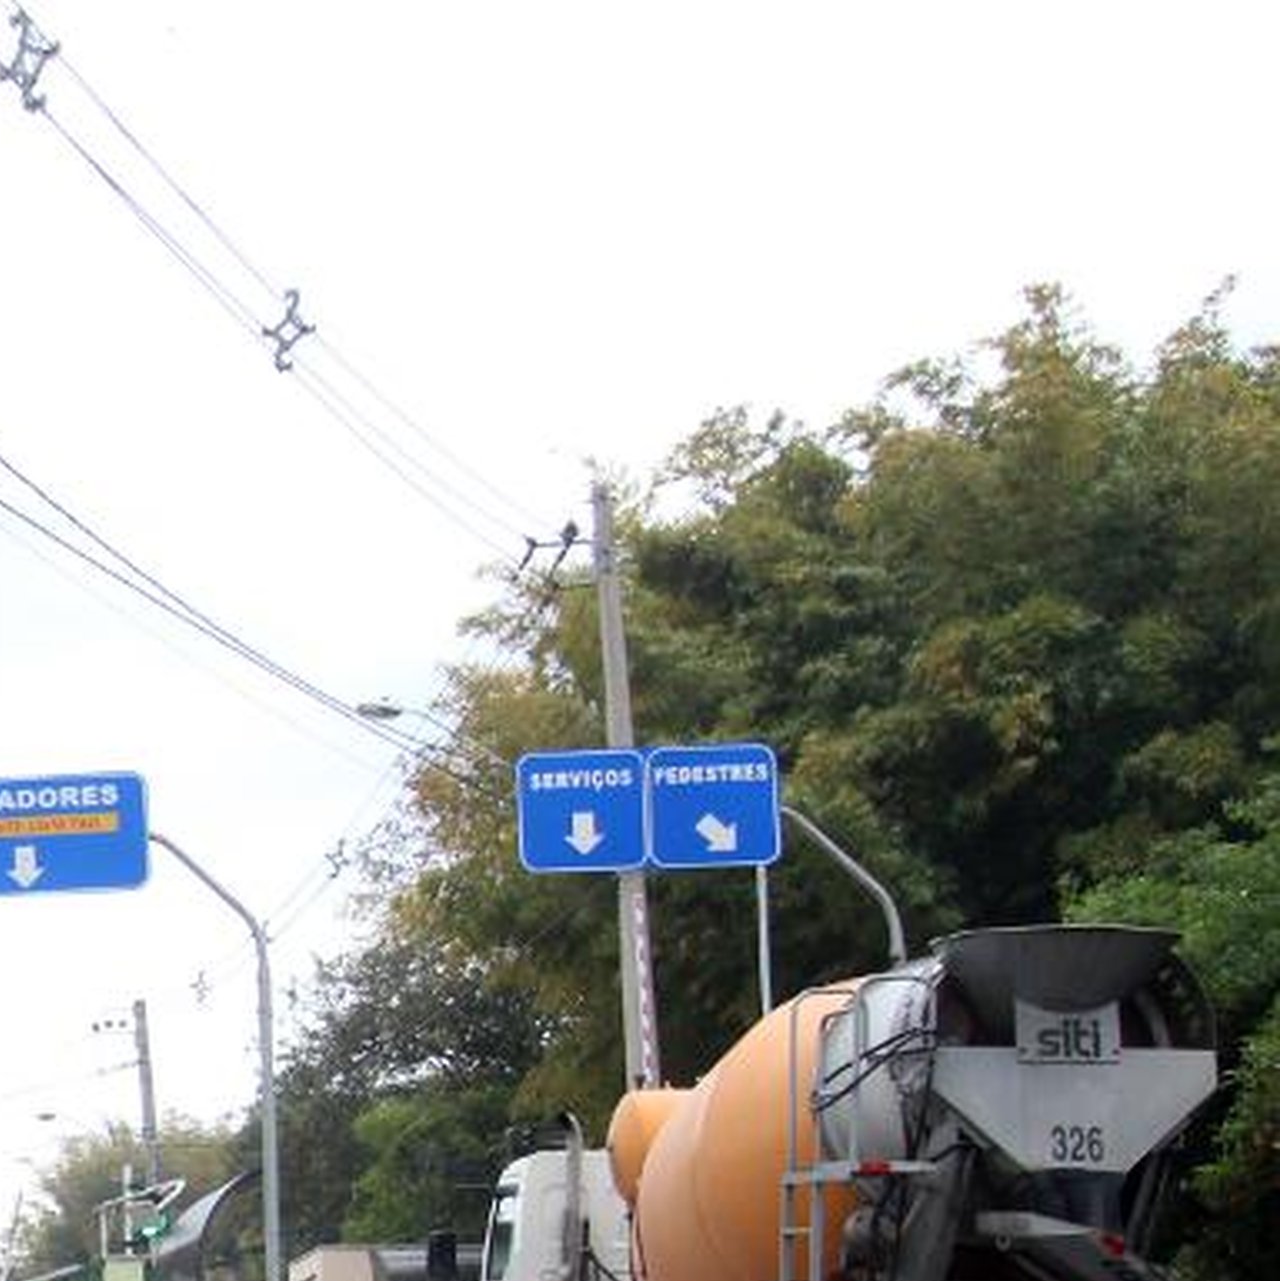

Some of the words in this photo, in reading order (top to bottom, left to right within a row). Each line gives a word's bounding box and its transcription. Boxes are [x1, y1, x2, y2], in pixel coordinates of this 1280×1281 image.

[530, 769, 633, 791] SERVIÇOS
[654, 763, 768, 786] PEDESTRES
[1037, 1019, 1102, 1058] siti
[1051, 1124, 1105, 1164] 326
